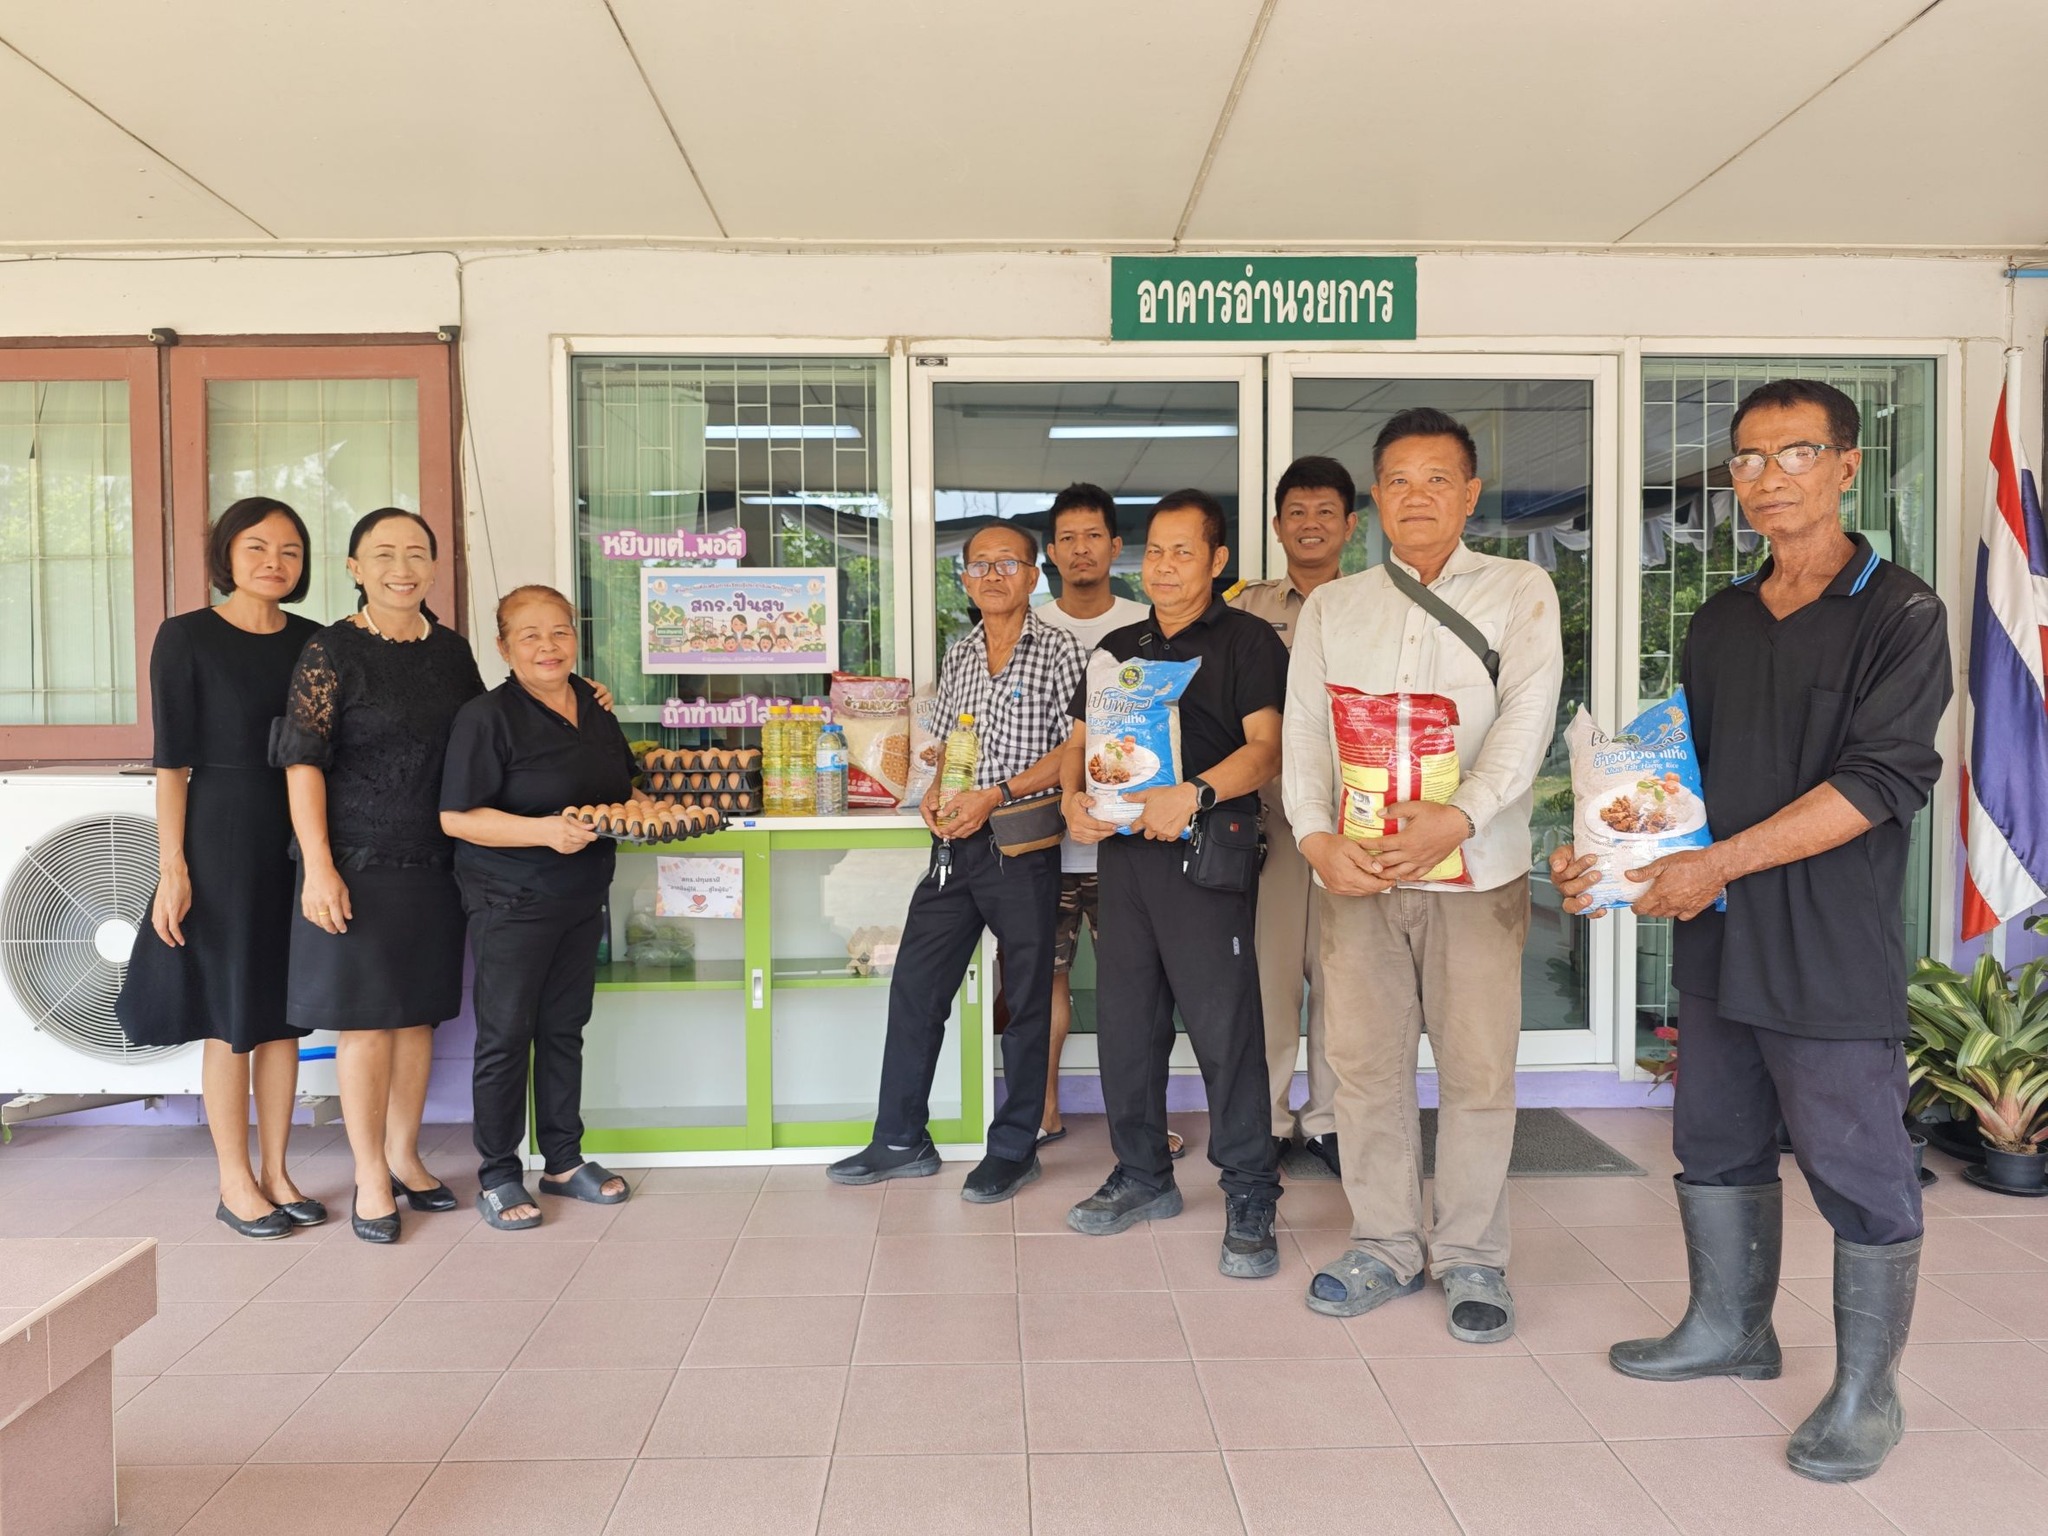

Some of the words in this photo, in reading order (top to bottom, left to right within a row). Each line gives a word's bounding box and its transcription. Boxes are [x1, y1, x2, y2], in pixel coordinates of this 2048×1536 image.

[1137, 264, 1394, 324] อาคารอำนวยการ
[690, 592, 785, 620] สกร.ปันสุข
